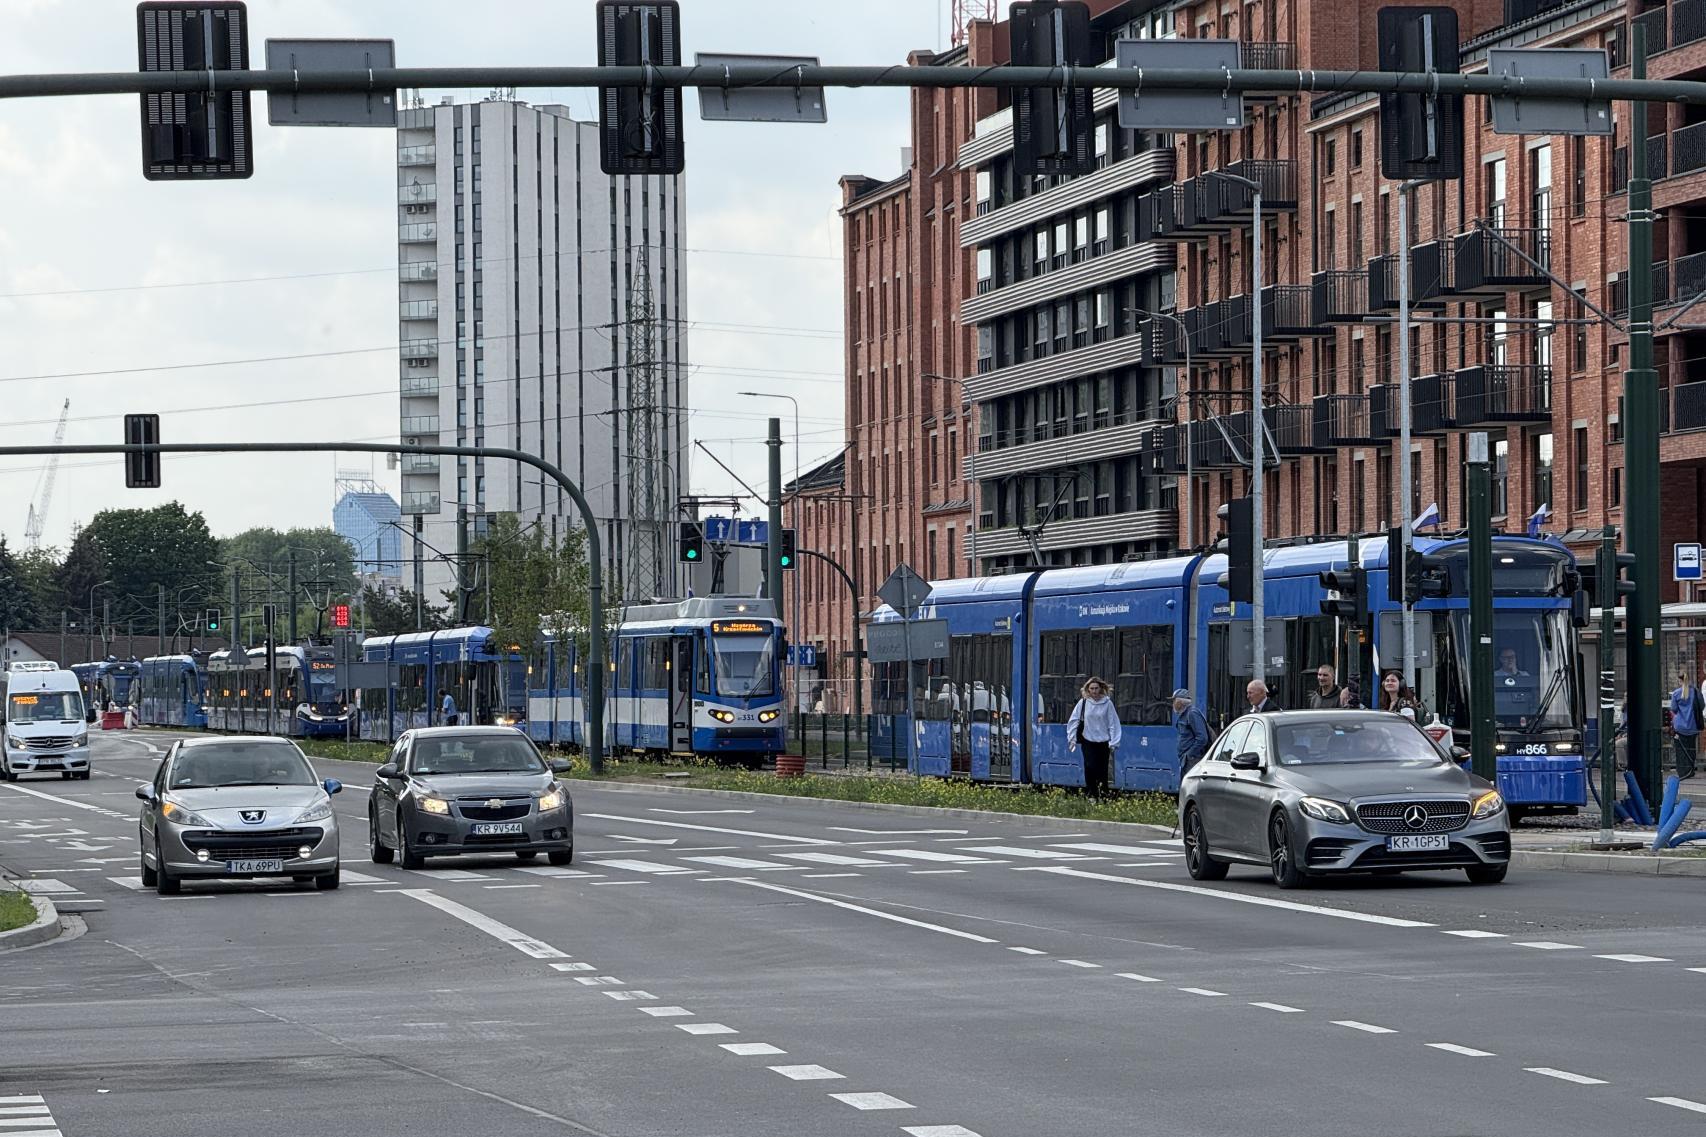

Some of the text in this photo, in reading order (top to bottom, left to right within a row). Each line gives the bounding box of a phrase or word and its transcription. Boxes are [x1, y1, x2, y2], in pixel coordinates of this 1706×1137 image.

[713, 623, 720, 633] 5
[477, 824, 521, 834] KR 9V544
[1393, 836, 1446, 849] KR 1GP51
[234, 861, 281, 872] TKA 69PU
